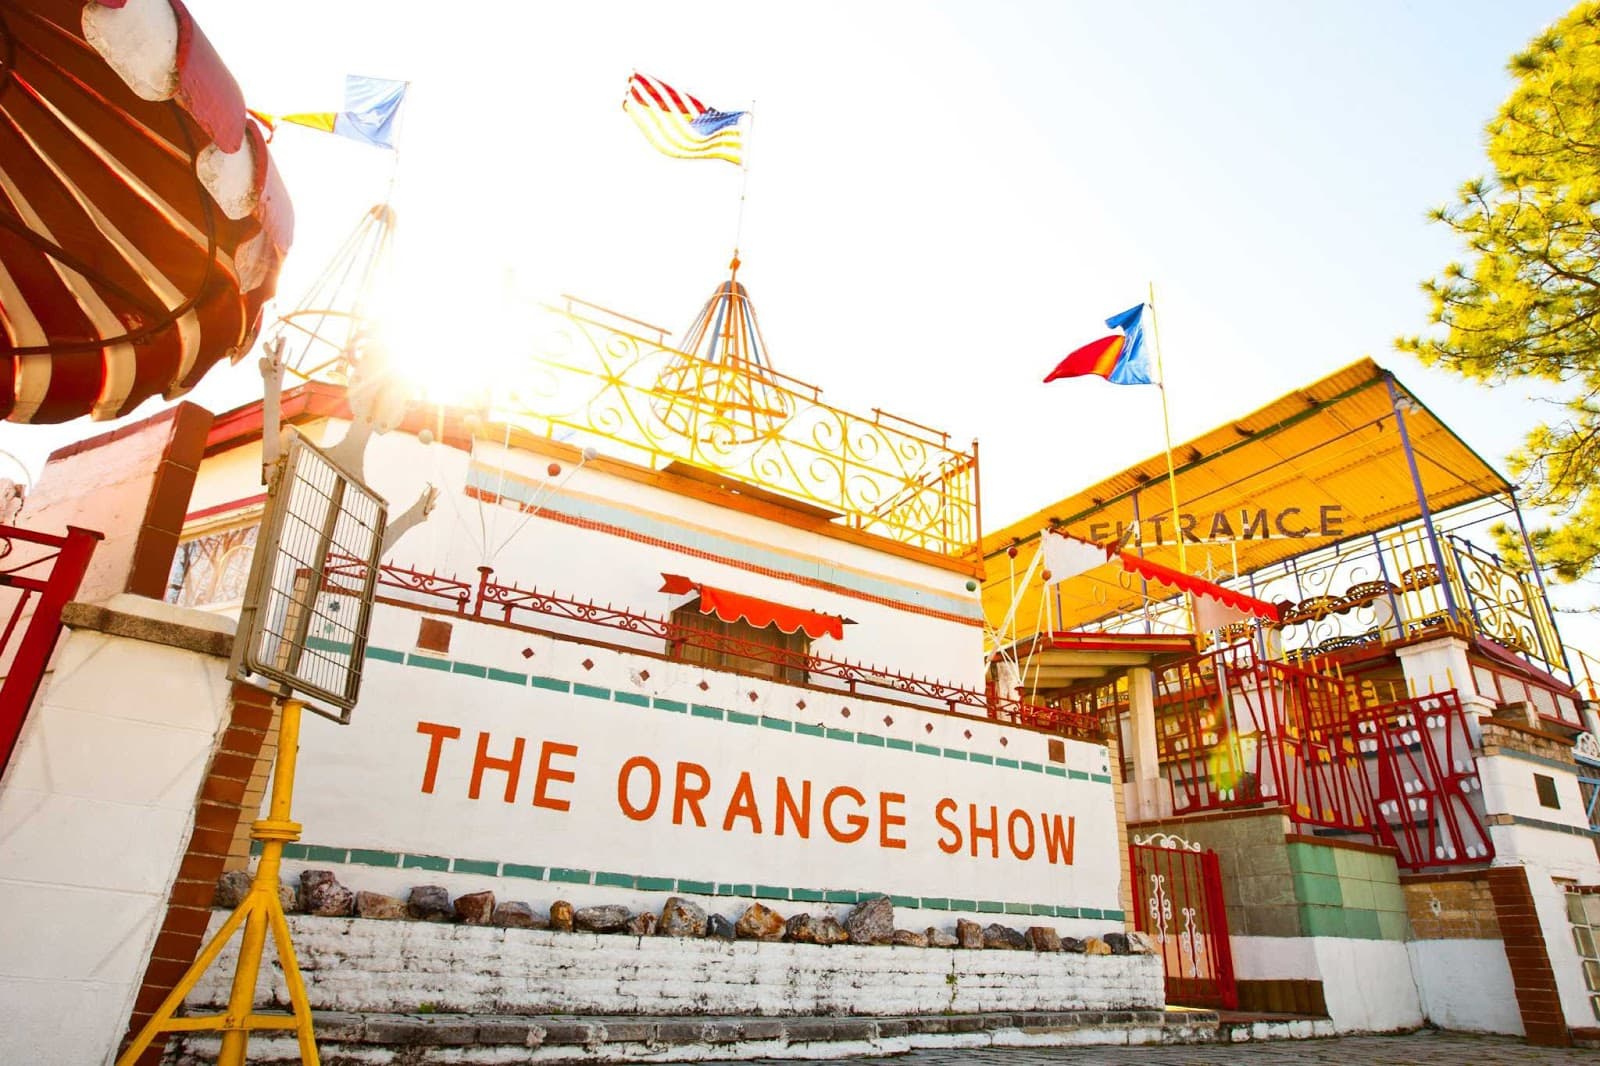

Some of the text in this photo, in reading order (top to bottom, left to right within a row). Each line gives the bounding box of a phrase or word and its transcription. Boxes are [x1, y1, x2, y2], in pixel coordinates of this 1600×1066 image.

[416, 722, 1075, 866] THE ORANGE SHOW
